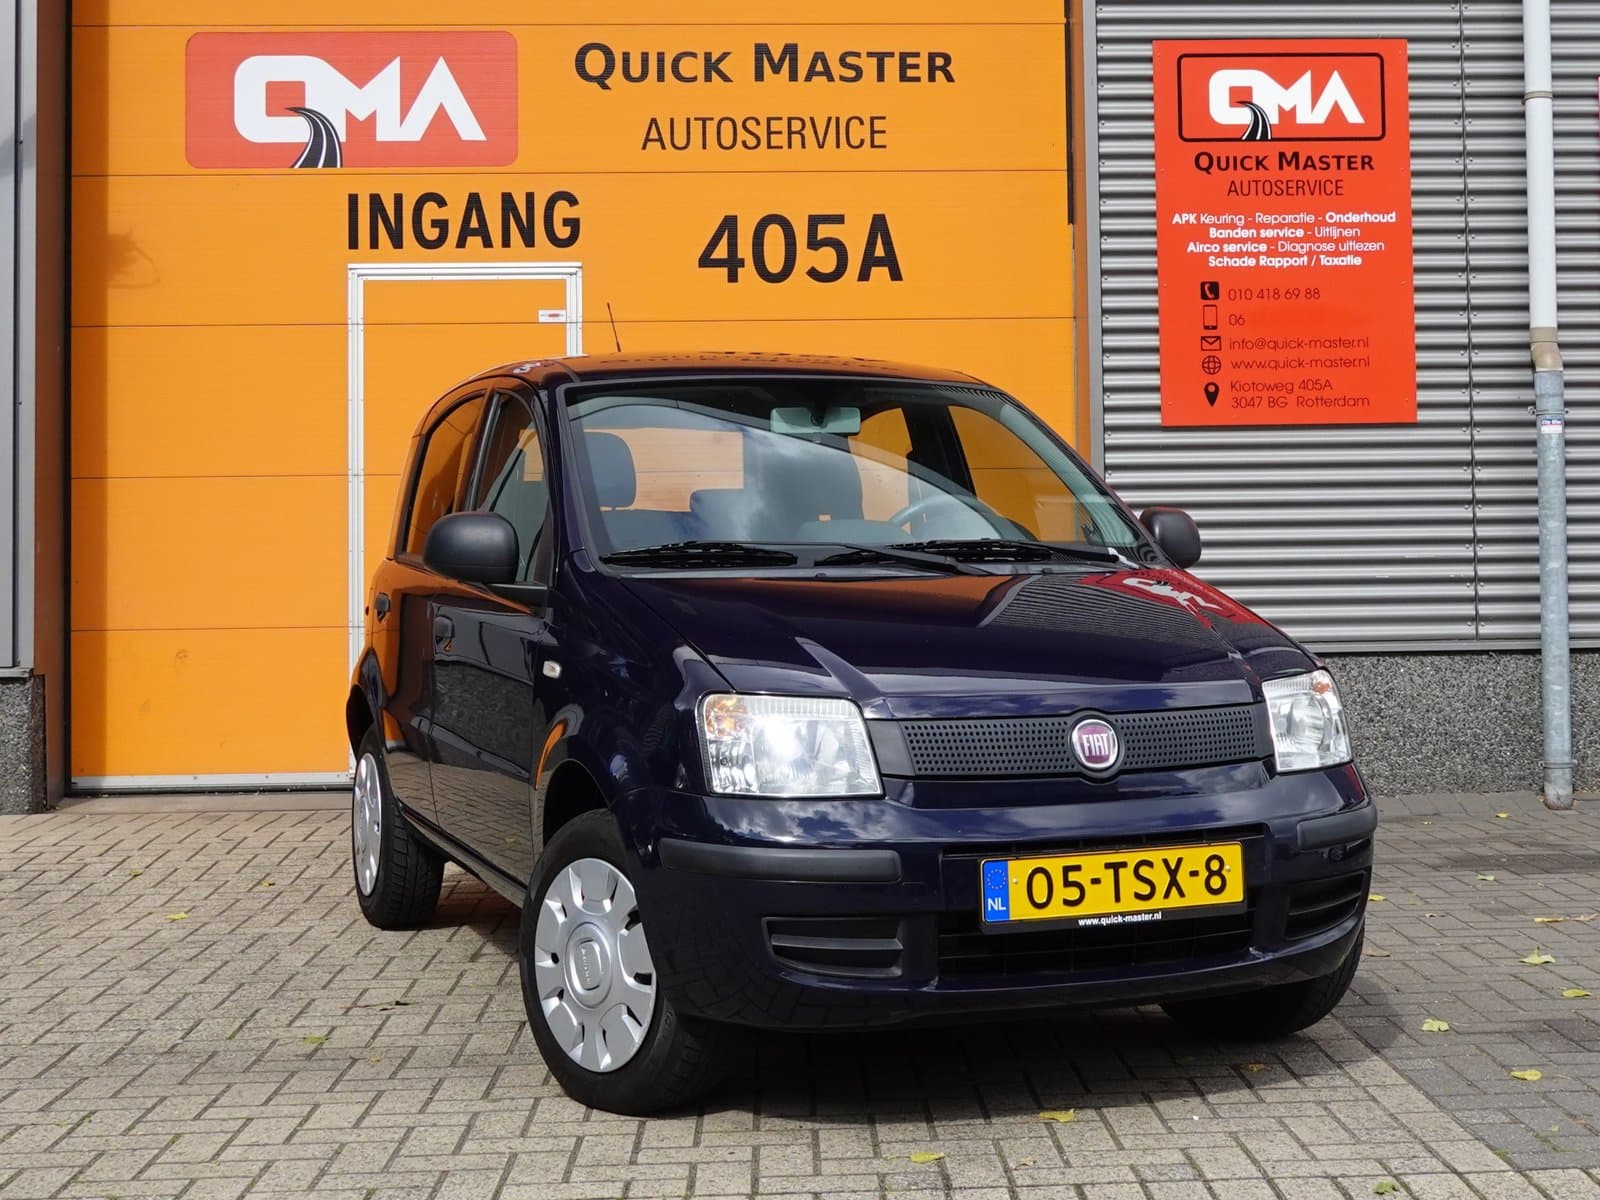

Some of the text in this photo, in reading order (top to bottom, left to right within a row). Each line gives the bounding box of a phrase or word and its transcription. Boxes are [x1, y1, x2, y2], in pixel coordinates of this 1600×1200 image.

[641, 116, 887, 151] AUTOSERVICE
[1227, 179, 1344, 197] AUTOSERVICE
[347, 191, 581, 250] INGANG
[1172, 213, 1197, 224] APK
[1200, 212, 1245, 226] Keuring
[1255, 212, 1315, 226] Reparatie
[1325, 211, 1396, 223] Onderhoud
[1209, 227, 1257, 239] Banden
[1259, 227, 1304, 238] service
[1314, 226, 1361, 240] Uitlijnen
[698, 213, 904, 284] 405A
[1187, 241, 1220, 253] Airco
[1222, 241, 1267, 252] service
[1278, 240, 1335, 254] Diagnose
[1338, 239, 1385, 251] uitlezen
[1208, 256, 1257, 267] Schade
[1259, 255, 1308, 269] Rapport
[1319, 254, 1362, 266] Taxatie
[1228, 287, 1321, 301] 010 418 69 88
[1228, 313, 1246, 326] 06
[1229, 336, 1369, 352] info@quick-master.nl
[1230, 355, 1370, 371] www.quick-master.nl
[1230, 378, 1333, 394] Kiotoweg 405A
[1231, 394, 1371, 409] 3047 BG Rotterdam
[1081, 733, 1109, 757] FIAT
[1026, 853, 1228, 910] 05-TSX-8
[987, 897, 1007, 912] NL
[1078, 911, 1162, 927] www.quick-master.nl
